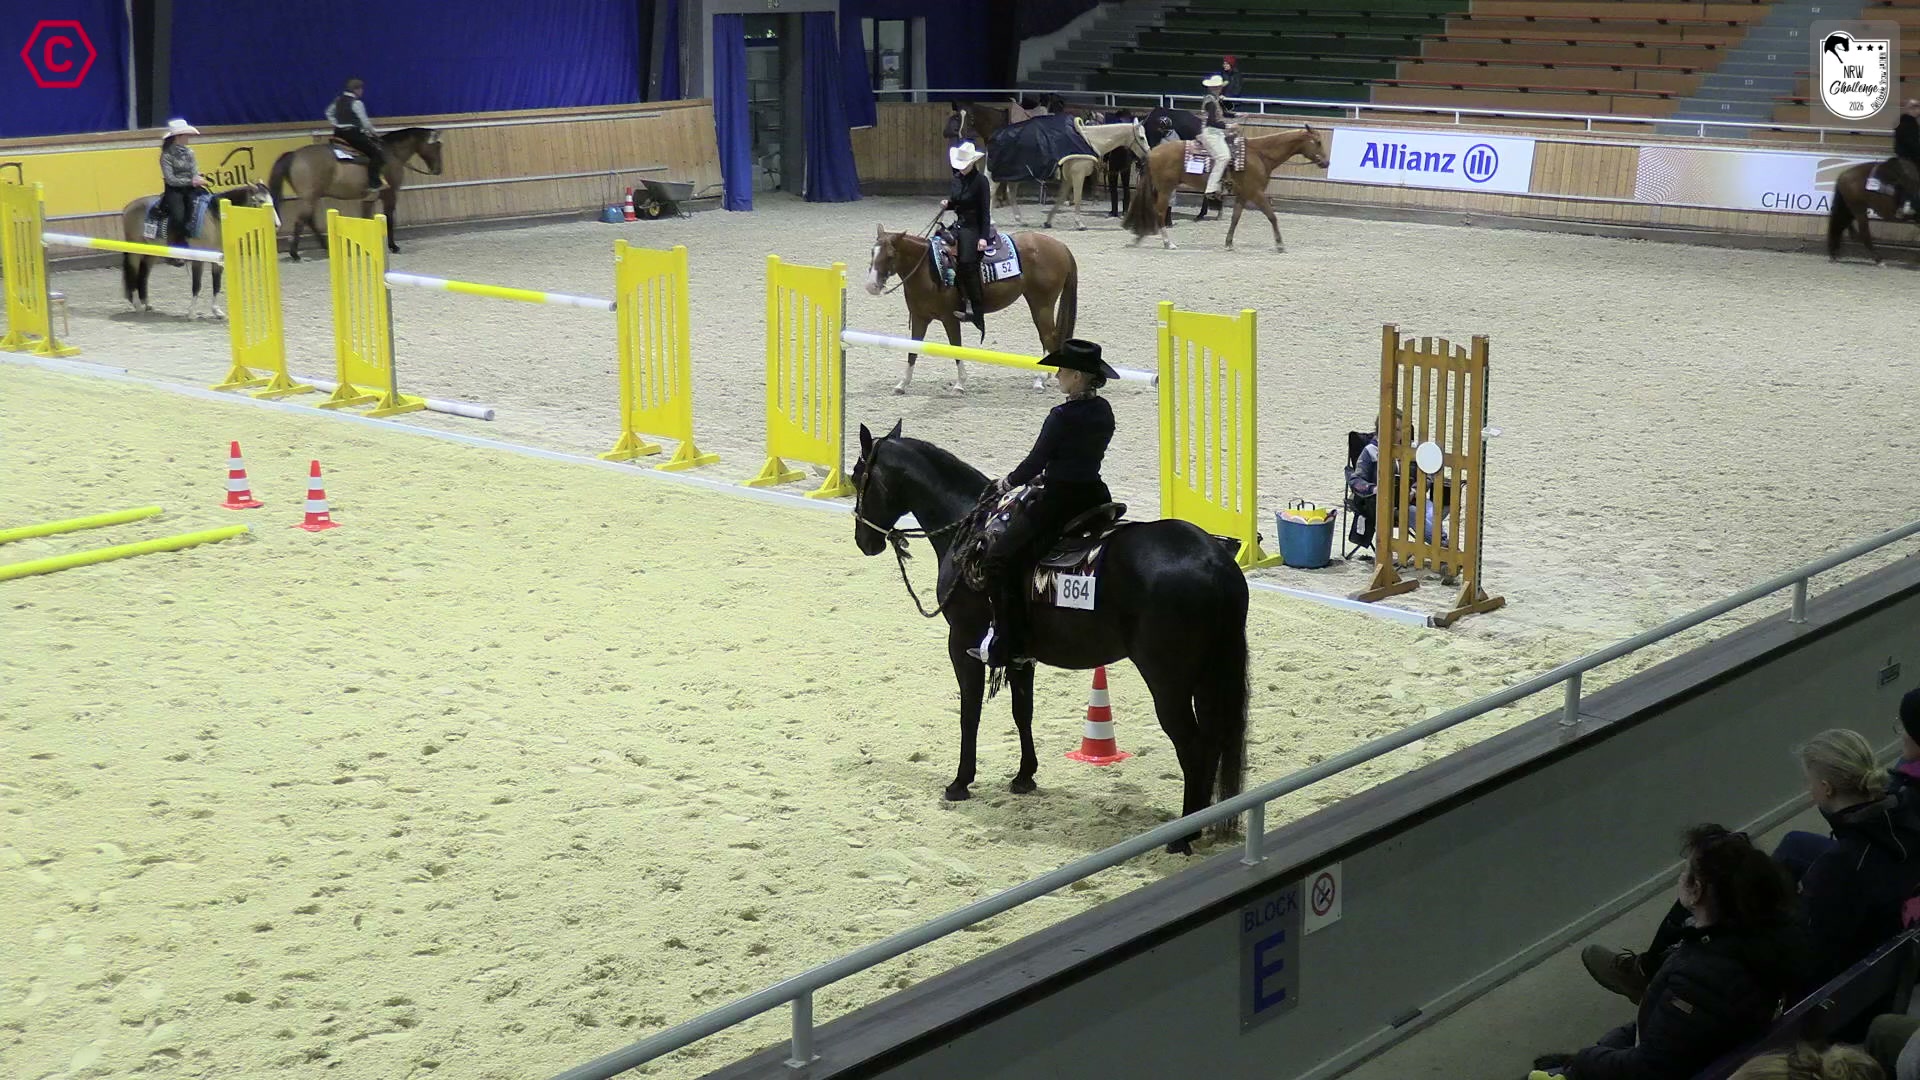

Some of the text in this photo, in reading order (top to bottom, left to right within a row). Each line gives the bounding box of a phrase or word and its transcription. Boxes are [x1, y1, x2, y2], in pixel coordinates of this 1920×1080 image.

[1360, 142, 1456, 173] Allianz
[199, 165, 249, 188] stall
[1761, 192, 1812, 210] CHIO
[1001, 261, 1013, 273] 52
[1063, 578, 1090, 600] 864
[1244, 890, 1298, 933] BLOCK
[1254, 930, 1286, 1014] E
